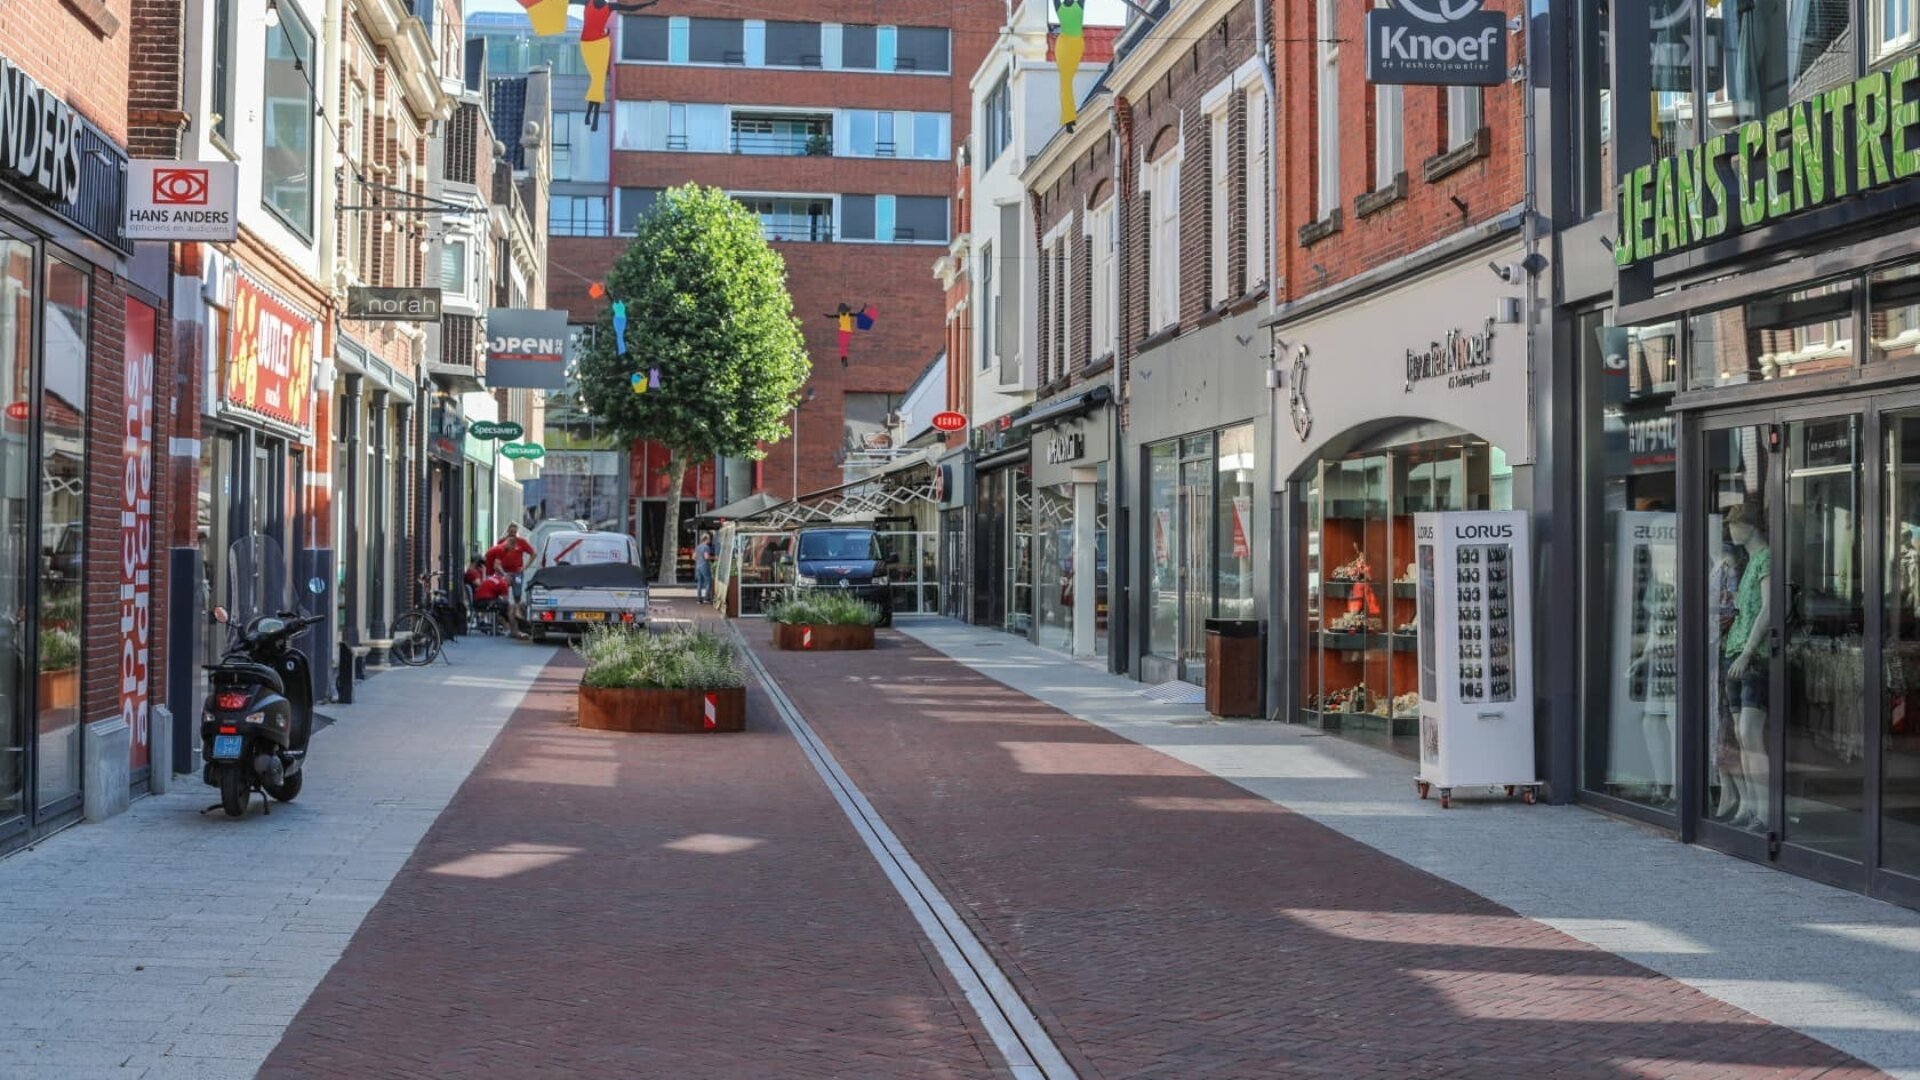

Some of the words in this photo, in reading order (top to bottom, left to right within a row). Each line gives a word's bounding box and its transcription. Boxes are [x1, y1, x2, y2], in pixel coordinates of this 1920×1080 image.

[1381, 26, 1498, 61] Knoef
[1615, 134, 1727, 266] JEANS
[1739, 55, 1920, 226] CENTRE
[130, 209, 169, 222] HANS
[172, 211, 229, 223] ANDERS
[368, 298, 436, 313] norah
[257, 309, 293, 378] OUTLET
[474, 424, 519, 436] Specsavers
[1417, 526, 1434, 539] LORUS
[1456, 524, 1513, 539] LORUS
[120, 360, 139, 748] opticiens
[135, 352, 154, 747] audiciens
